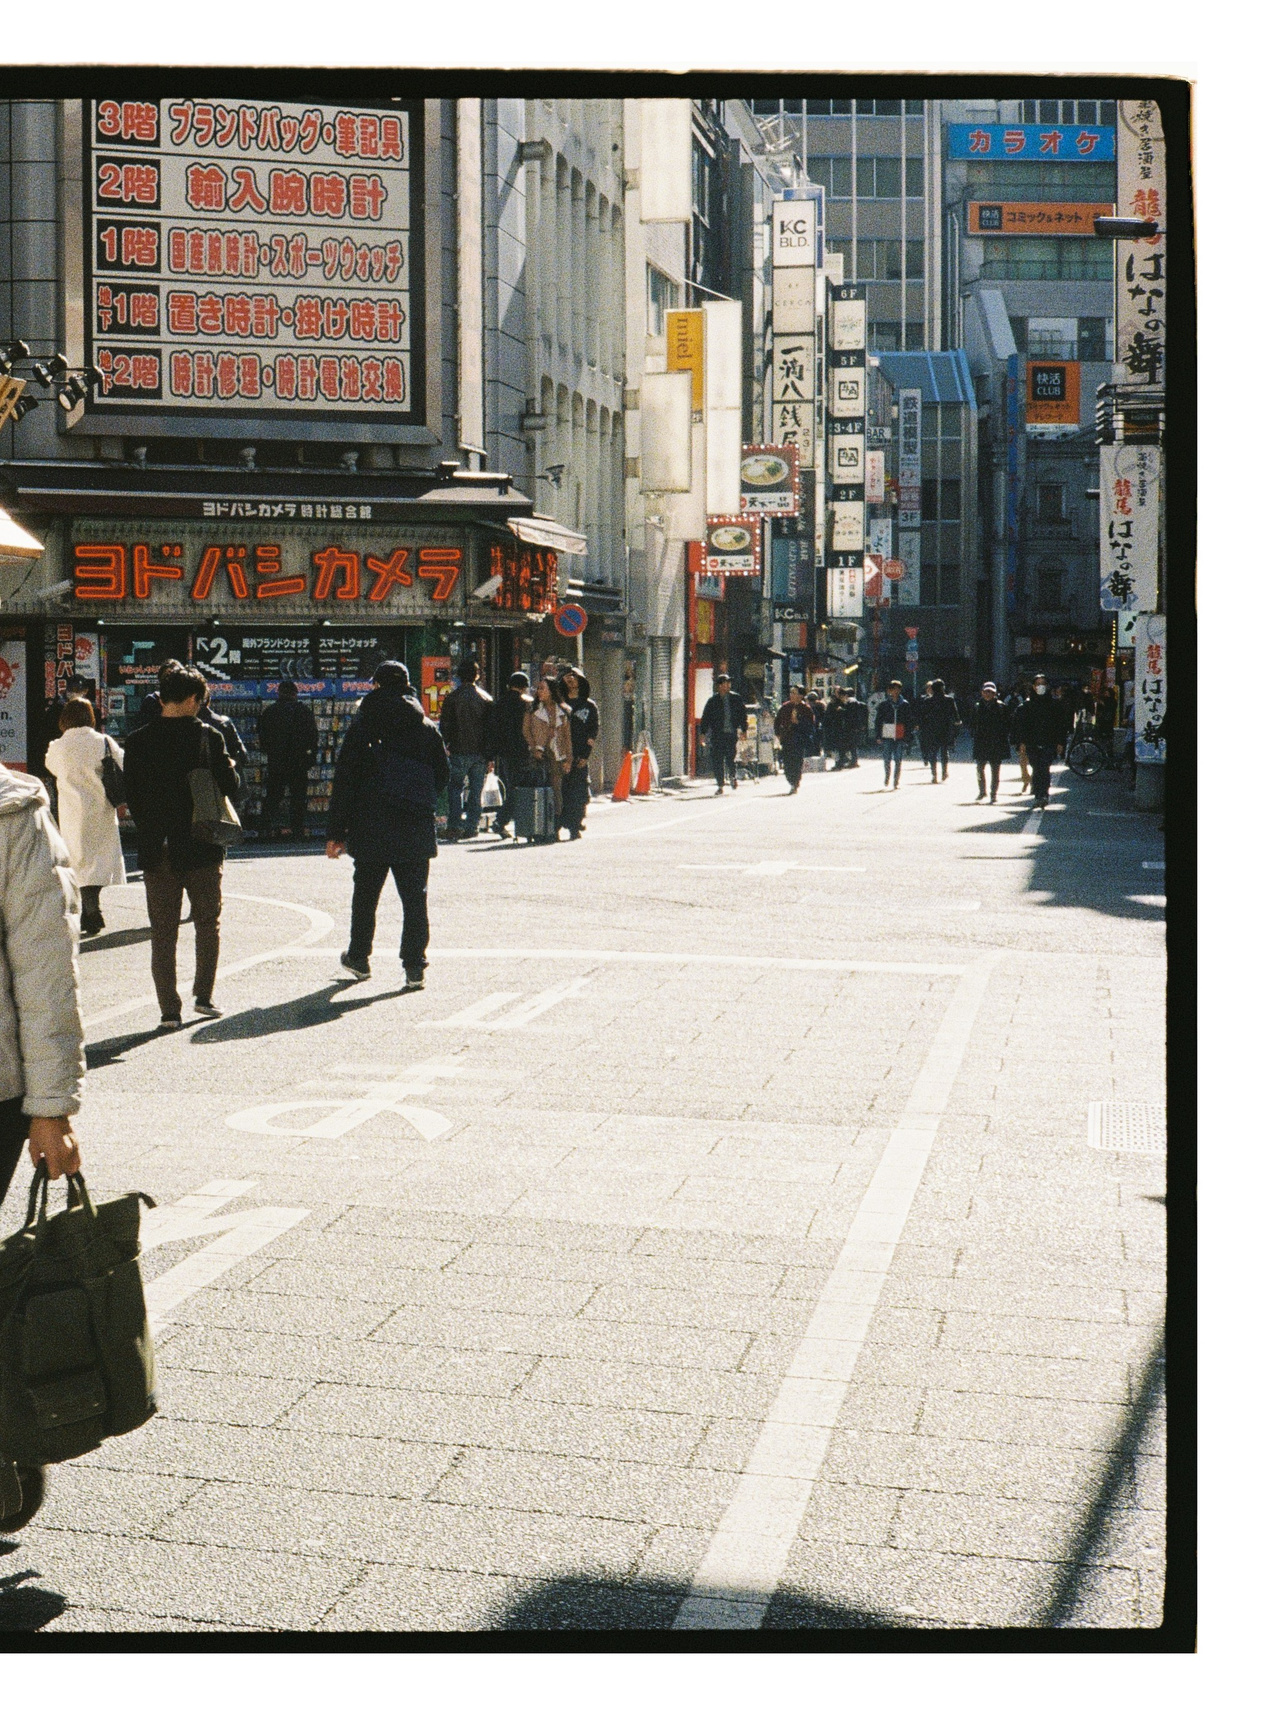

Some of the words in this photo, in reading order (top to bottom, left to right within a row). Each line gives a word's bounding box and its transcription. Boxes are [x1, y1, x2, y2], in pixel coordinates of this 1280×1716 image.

[97, 99, 158, 142] 3階
[169, 104, 405, 161] ブランドバッグ・筆記具
[970, 129, 1116, 155] カラオケ
[98, 161, 158, 205] 2階
[185, 163, 387, 220] 輸入腕時計
[99, 225, 158, 268] 1階
[780, 219, 806, 235] KC
[780, 237, 810, 248] BLD.
[168, 292, 405, 343] 置き時計・掛け時計
[170, 350, 405, 403] 時計修理・時計電池交換
[1037, 372, 1061, 385] 快活
[1037, 386, 1061, 396] CLUB
[203, 502, 297, 517] ヨドバシカメラ
[300, 504, 372, 519] 時計総合館
[74, 543, 462, 602] ヨドバシカメラ
